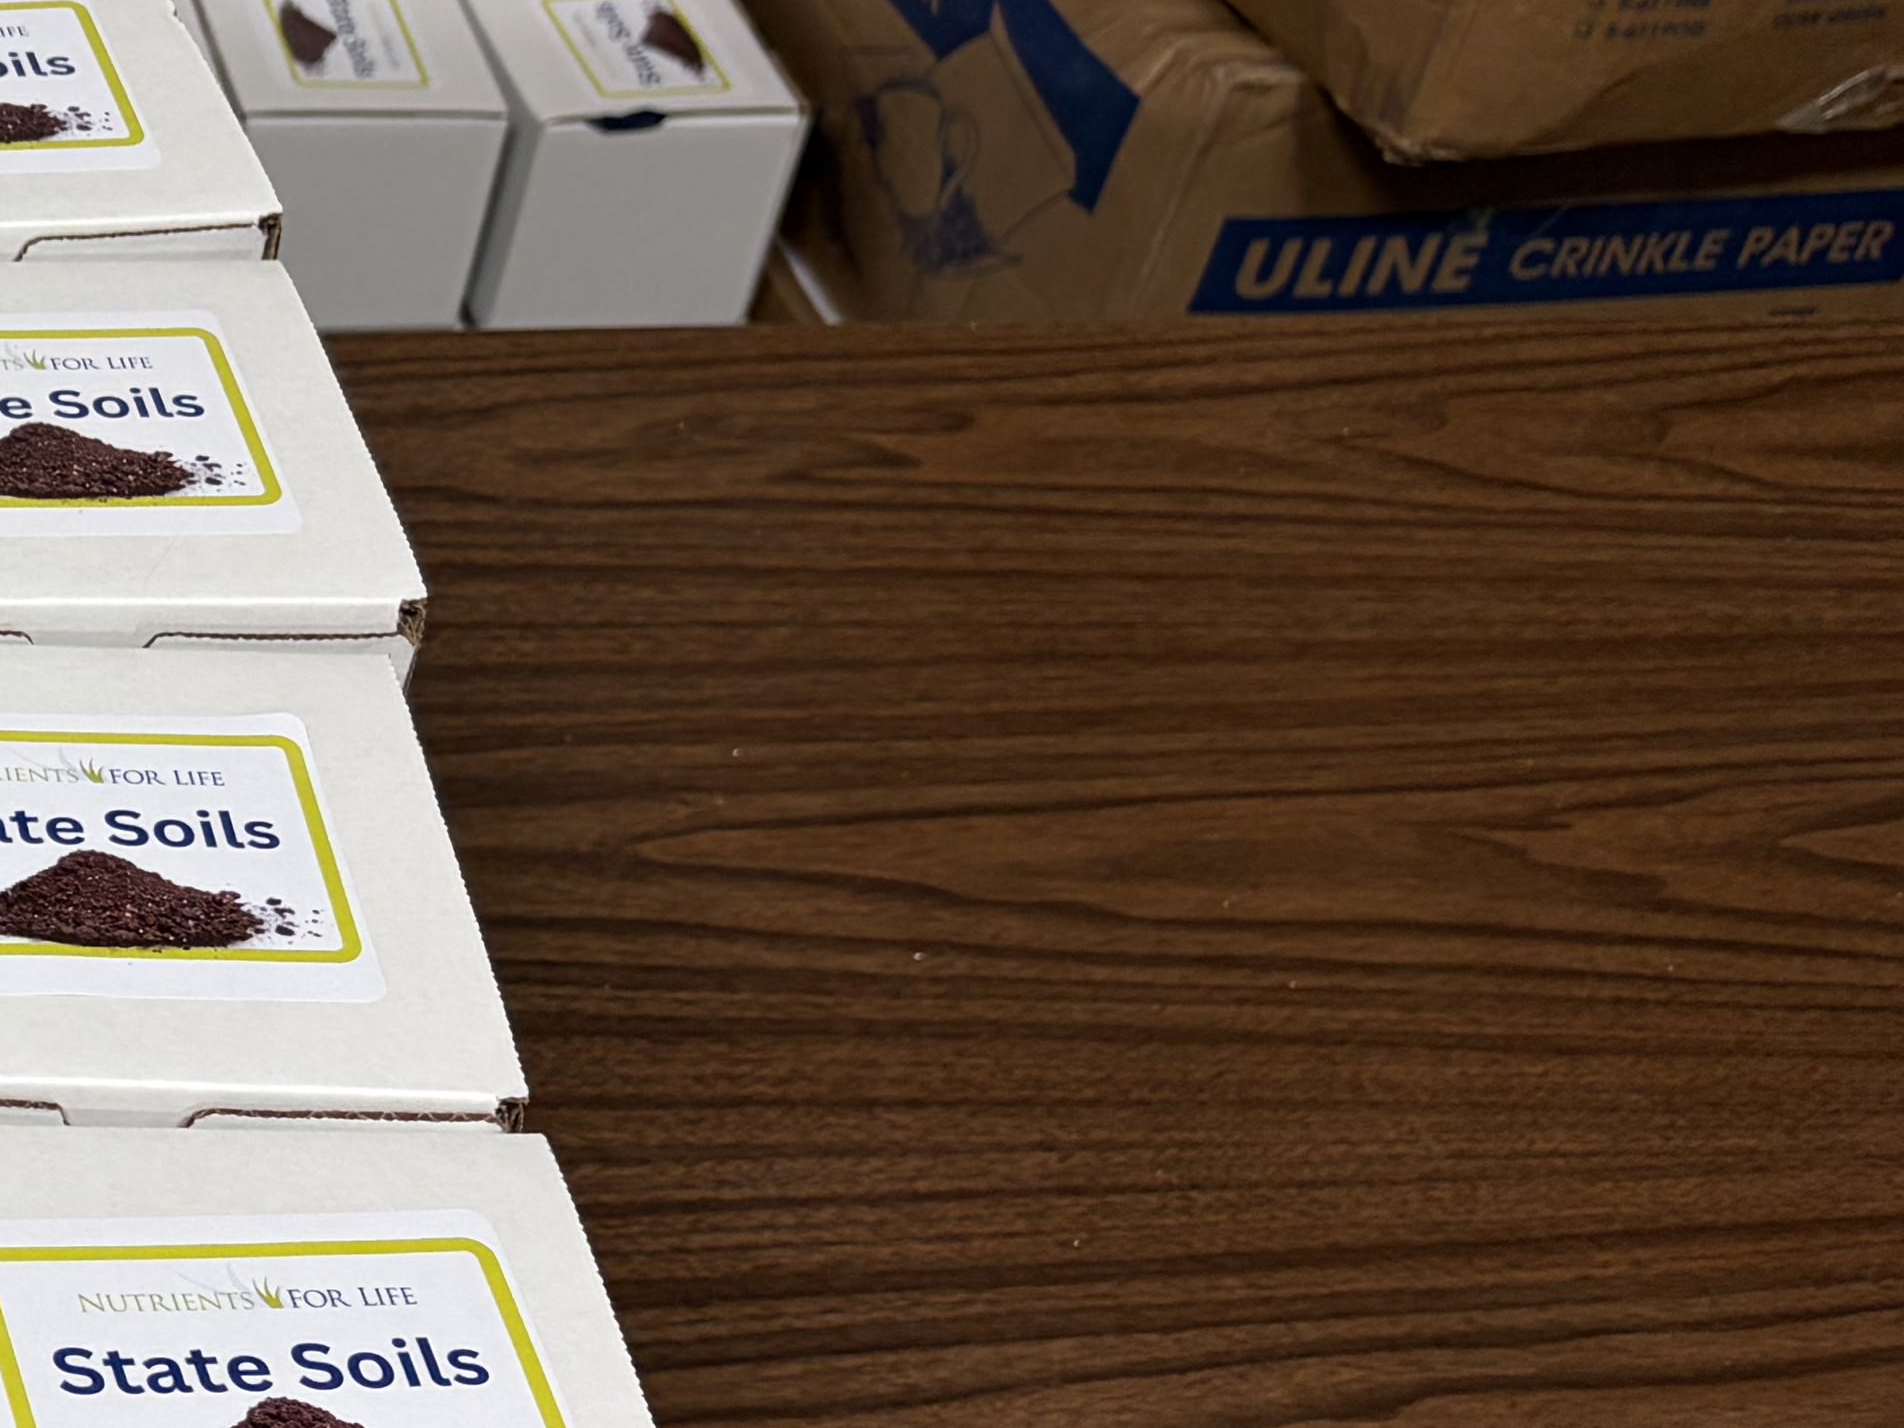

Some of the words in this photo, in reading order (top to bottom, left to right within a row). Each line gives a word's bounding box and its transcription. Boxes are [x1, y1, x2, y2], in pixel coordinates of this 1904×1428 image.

[1234, 229, 1490, 300] ULINE
[1508, 228, 1731, 282] CRINKLE
[1736, 219, 1896, 270] PAPER
[51, 357, 102, 370] FOR
[107, 356, 155, 369] LIFE
[51, 387, 205, 419] Soils
[110, 767, 167, 784] FOR
[174, 768, 226, 786] LIFE
[106, 808, 281, 849] Soils
[81, 1291, 259, 1313] NUTRIENTS
[289, 1288, 354, 1309] FOR
[360, 1286, 420, 1306] LIFE
[54, 1348, 276, 1396] State
[294, 1337, 491, 1391] Soils
